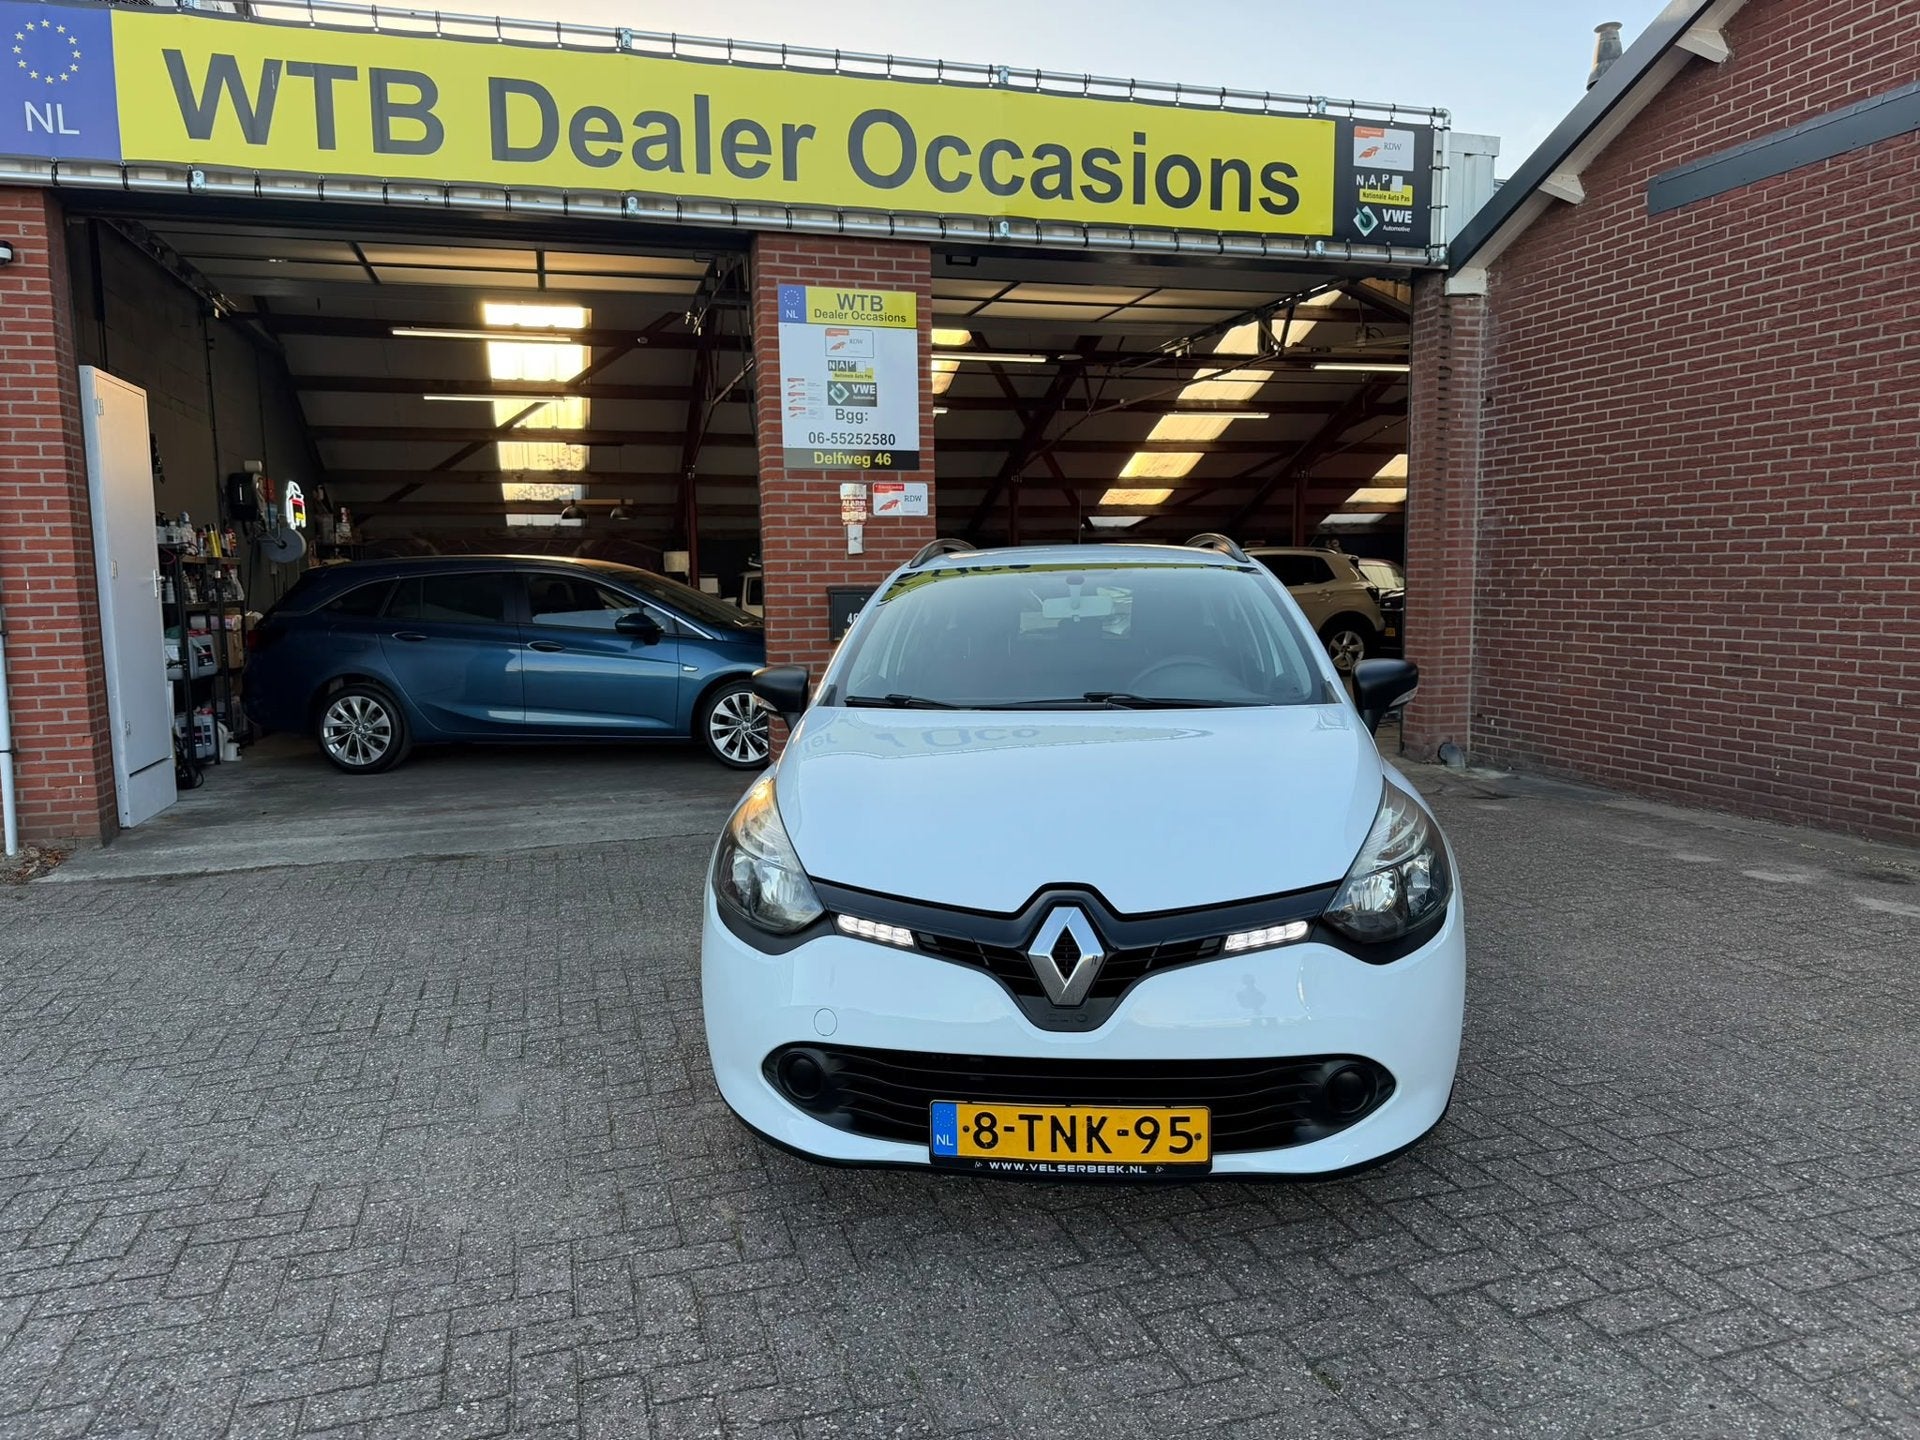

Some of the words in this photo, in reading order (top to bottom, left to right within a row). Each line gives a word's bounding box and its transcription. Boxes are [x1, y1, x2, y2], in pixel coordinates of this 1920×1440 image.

[24, 100, 81, 136] NL
[161, 48, 446, 156] WTB
[488, 75, 816, 182] Dealer
[847, 108, 1301, 215] Occasions
[1383, 142, 1402, 151] RDW
[1362, 191, 1387, 200] Nationale
[1388, 193, 1400, 202] Auto
[1382, 208, 1412, 224] VWE
[1382, 224, 1411, 232] Automotive
[836, 293, 884, 312] WTB
[786, 310, 799, 319] NL
[814, 308, 848, 320] Dealer
[851, 310, 907, 323] Occasions
[852, 384, 876, 394] VWE
[835, 408, 868, 424] Bgg:
[808, 431, 896, 446] 06-55252580
[813, 451, 871, 467] Delfweg
[874, 453, 892, 466] 46
[972, 1111, 1194, 1154] 8-TNK-95
[936, 1134, 954, 1147] NL
[989, 1161, 1148, 1174] WWW.VELSERBEEK.NL
